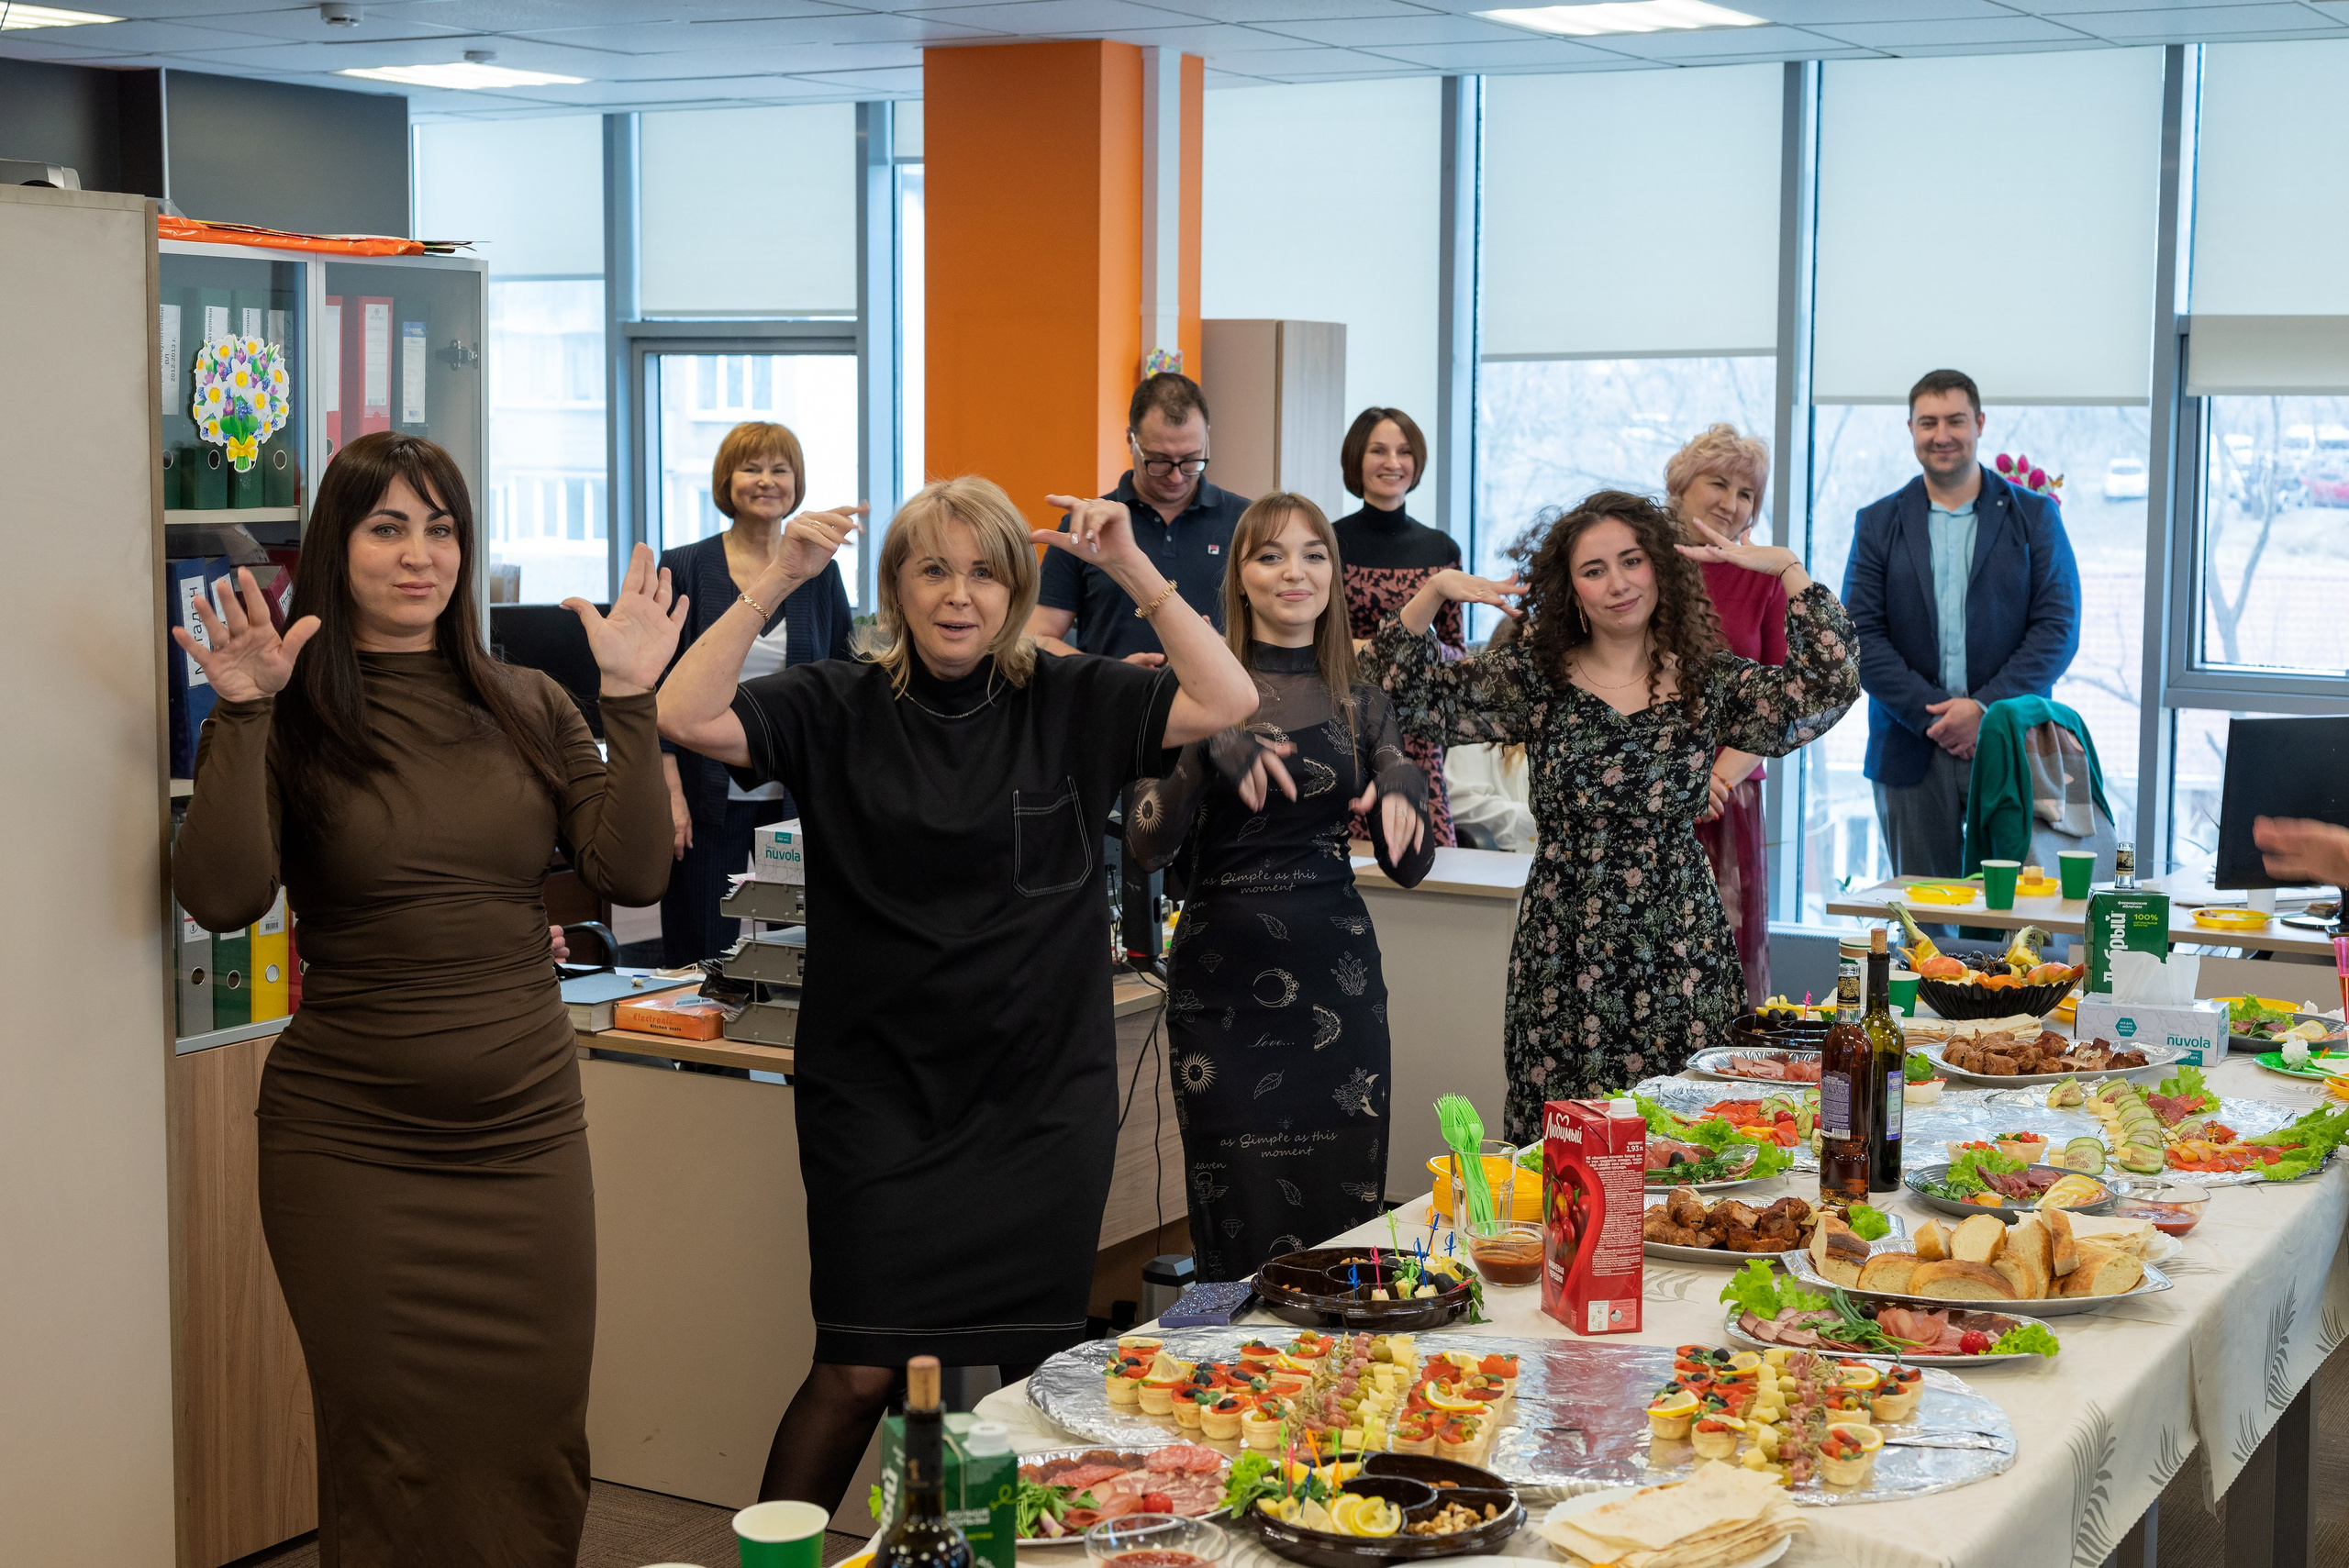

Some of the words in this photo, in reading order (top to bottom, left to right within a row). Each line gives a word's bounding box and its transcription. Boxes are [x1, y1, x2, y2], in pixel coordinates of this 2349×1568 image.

[765, 849, 801, 862] nuvola
[1202, 877, 1217, 886] as
[1220, 870, 1272, 885] Simple
[1275, 872, 1290, 881] as
[1293, 869, 1318, 880] this
[1240, 882, 1297, 895] moment
[2133, 913, 2159, 921] 100%
[2103, 912, 2129, 983] рый
[632, 1012, 674, 1025] Electronic
[2166, 1036, 2210, 1049] nuvola
[1543, 1111, 1582, 1145] Любимый
[1220, 1139, 1235, 1147] as
[1240, 1132, 1292, 1148] Simple
[1294, 1135, 1310, 1143] as
[1311, 1129, 1339, 1141] this
[1261, 1146, 1315, 1158] moment
[1194, 1162, 1228, 1170] eaven
